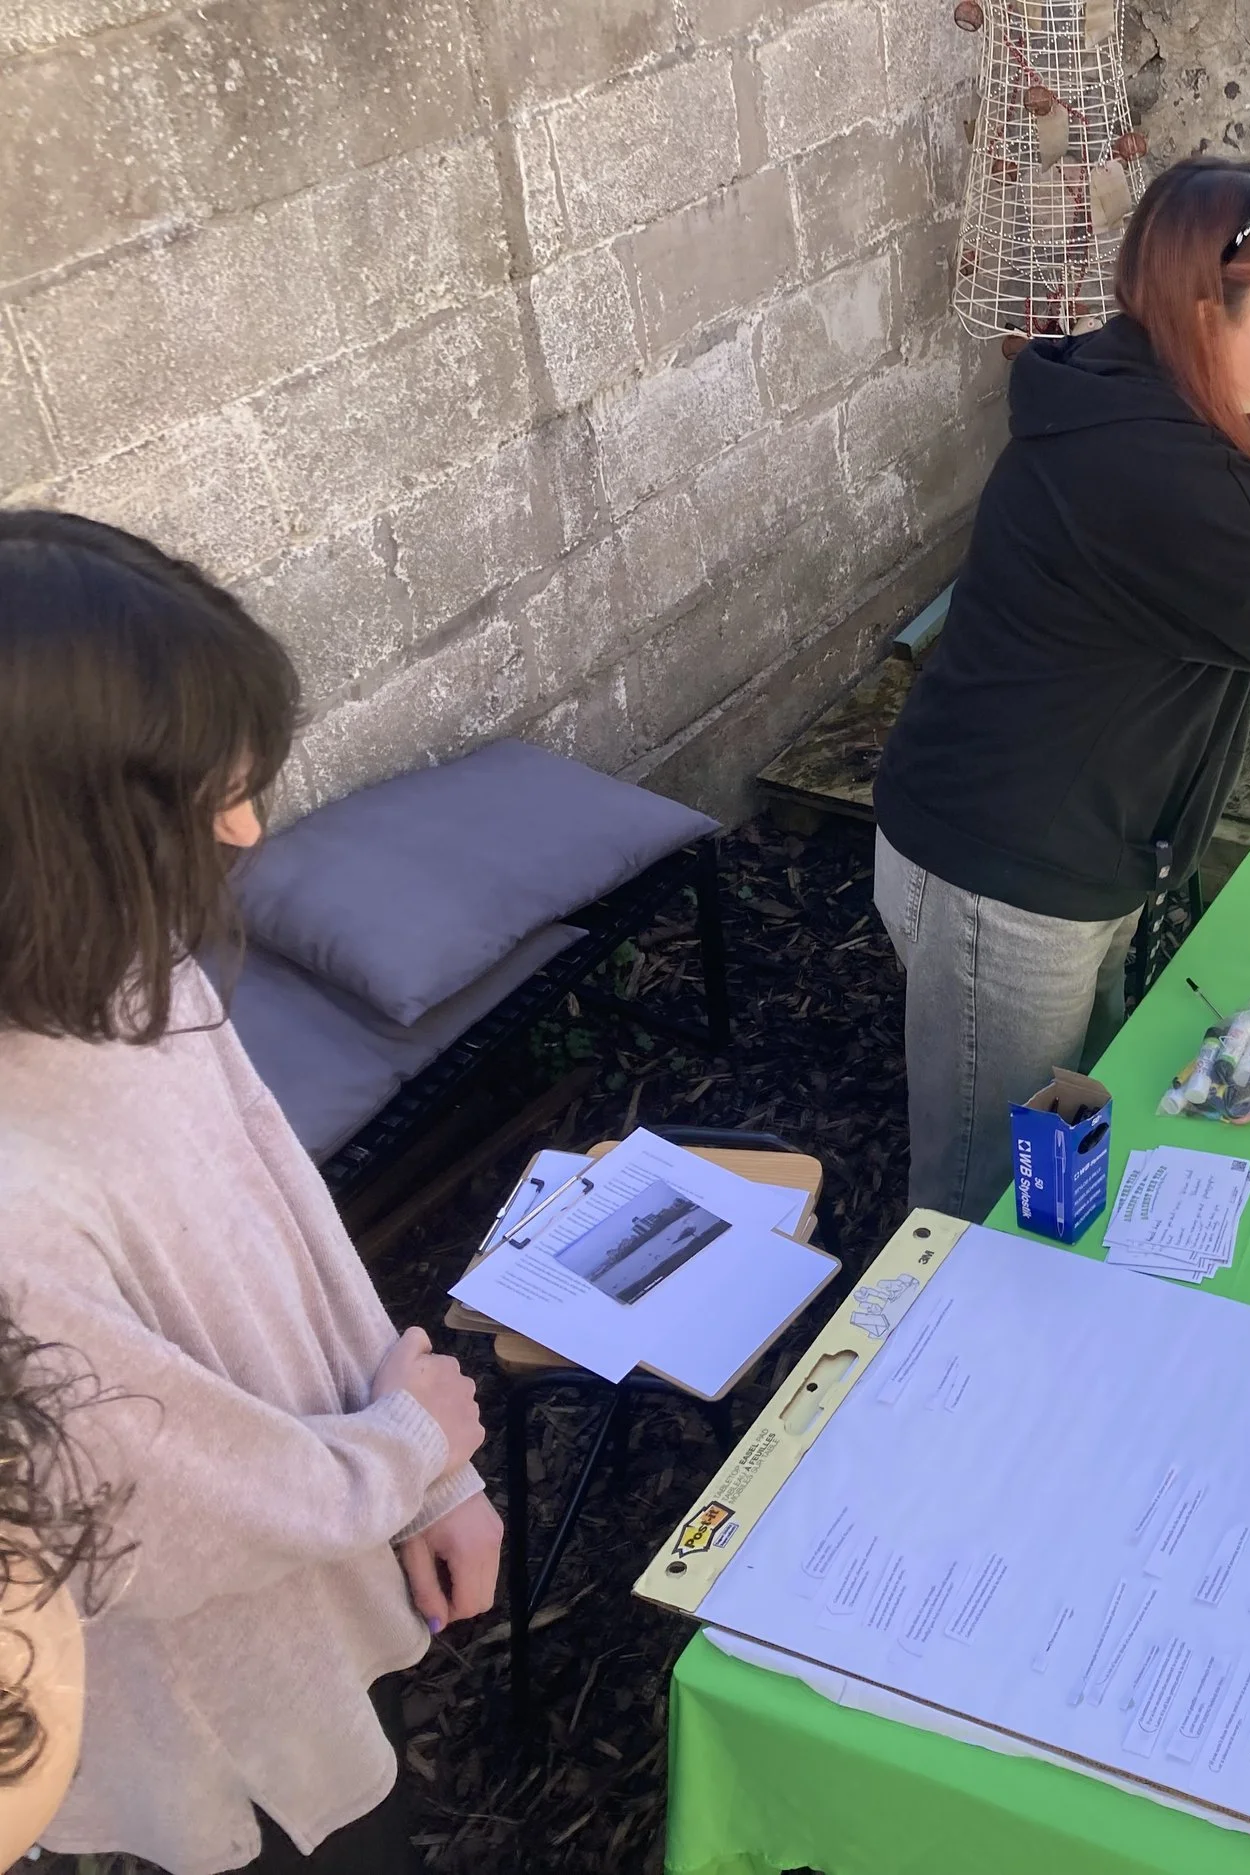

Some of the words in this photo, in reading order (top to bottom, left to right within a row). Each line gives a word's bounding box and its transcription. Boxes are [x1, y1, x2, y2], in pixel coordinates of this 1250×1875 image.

[1019, 1153, 1032, 1178] WB
[1019, 1177, 1032, 1219] Stylostik
[1034, 1177, 1044, 1190] 50
[918, 1250, 935, 1265] 3M
[739, 1441, 759, 1465] EASEL
[756, 1428, 768, 1442] PAD
[749, 1432, 775, 1465] FEUILLES
[762, 1437, 779, 1458] TABLE
[684, 1509, 719, 1549] Post-it
